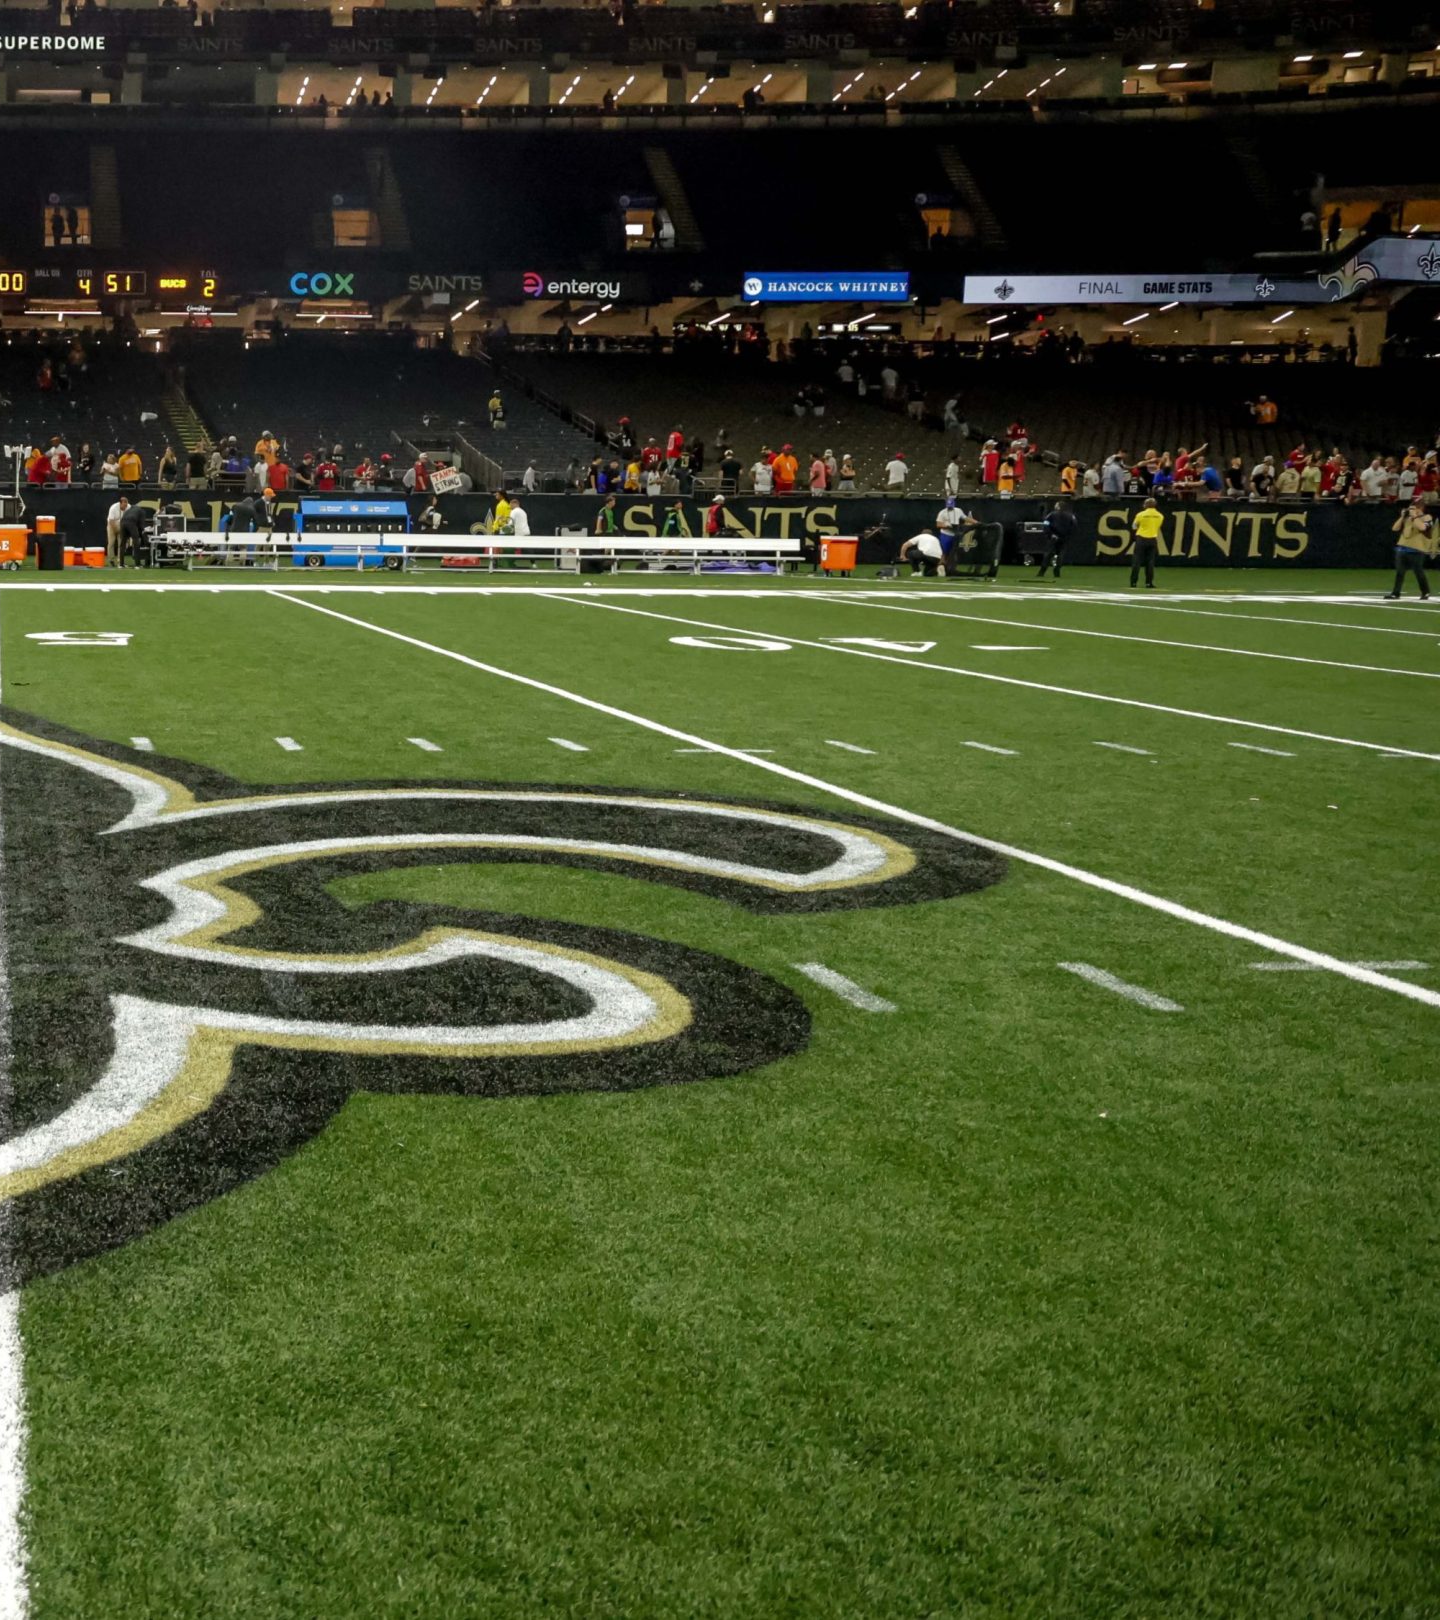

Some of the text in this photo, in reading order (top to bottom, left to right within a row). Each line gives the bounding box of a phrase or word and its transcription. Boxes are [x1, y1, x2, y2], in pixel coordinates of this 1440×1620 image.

[177, 37, 244, 52] SAINTS
[327, 38, 394, 53] SAINTS
[476, 37, 543, 53] SAINTS
[628, 36, 696, 52] SAINTS
[784, 33, 856, 50] SAINTS
[945, 31, 1020, 48] SAINTS
[79, 278, 90, 295] 4
[106, 274, 131, 293] 51
[159, 278, 187, 289] BUCS
[203, 279, 215, 298] 2
[289, 271, 355, 296] COX
[409, 275, 483, 291] SAINTS
[547, 277, 621, 298] entergy
[767, 282, 908, 293] HANCOCK WHITNEY
[1078, 281, 1213, 295] FINAL GAME STATS
[820, 543, 828, 561] G
